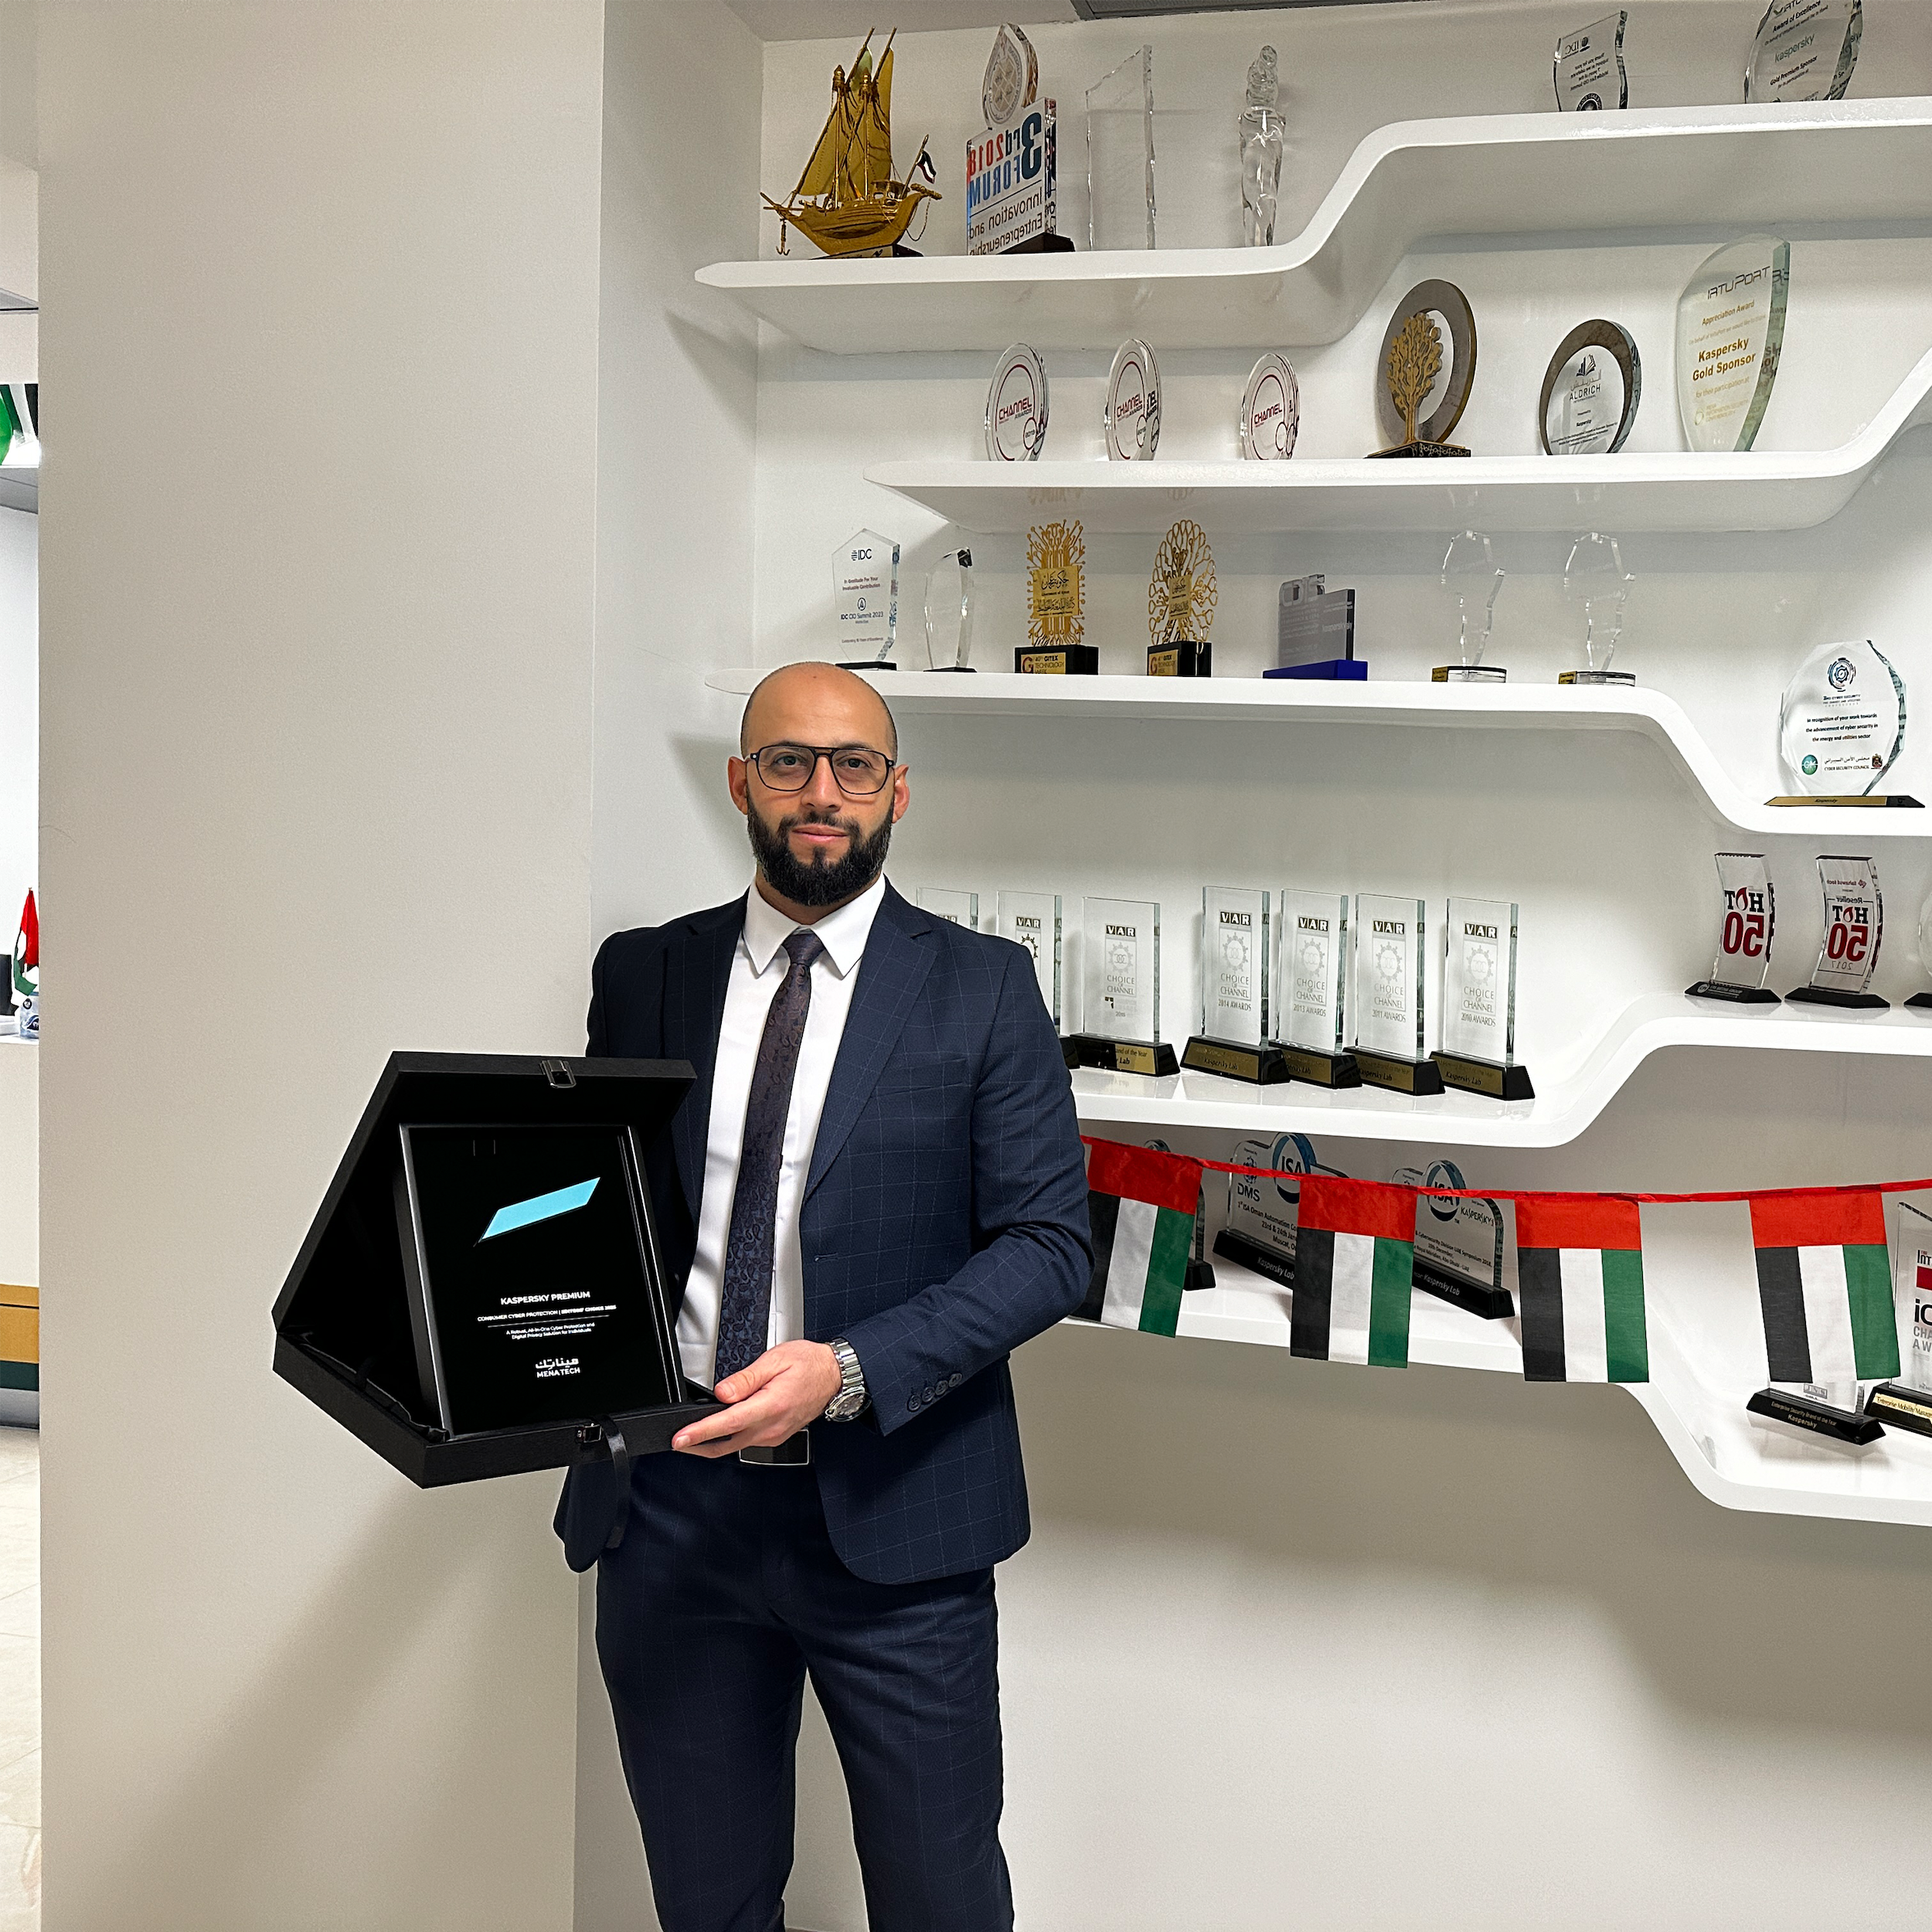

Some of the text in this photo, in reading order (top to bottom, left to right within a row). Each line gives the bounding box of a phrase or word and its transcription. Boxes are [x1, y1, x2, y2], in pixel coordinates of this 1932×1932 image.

[1773, 17, 1789, 32] Award
[1774, 34, 1815, 63] kaspersky
[1702, 308, 1736, 326] Appreciation
[1736, 299, 1755, 313] Award
[1698, 338, 1749, 362] Kaspersky
[1692, 353, 1757, 381] Gold Sponsor
[1570, 384, 1600, 400] ALDRICH
[998, 397, 1032, 420] CHANNEL
[1117, 393, 1142, 418] CHANNEL
[1253, 403, 1282, 424] CHANNEL
[858, 549, 872, 560] IDC
[1016, 917, 1041, 928] VAR
[1220, 912, 1251, 926] VAR
[1298, 917, 1328, 931] VAR
[1106, 925, 1136, 937] VAR
[1373, 920, 1405, 934] VAR
[1464, 923, 1498, 939] VAR
[1107, 975, 1135, 985] CHOICE
[1220, 973, 1250, 985] CHOICE
[1297, 978, 1325, 991] CHOICE
[1107, 985, 1134, 995] CHANNEL
[1220, 986, 1249, 998] CHANNEL
[1374, 983, 1404, 996] CHOICE
[1464, 986, 1495, 1000] CHOICE
[1296, 991, 1325, 1004] CHANNEL
[1374, 996, 1403, 1009] CHANNEL
[1218, 998, 1251, 1012] 2014 AWARDS
[1293, 1004, 1327, 1017] 2013 AWARDS
[1463, 1000, 1494, 1013] CHANNEL
[1383, 1010, 1406, 1022] AWARDS
[1472, 1015, 1496, 1027] AWARDS
[1203, 1058, 1239, 1070] Kaspersky Lab
[1301, 1066, 1311, 1074] Lab
[1446, 1071, 1481, 1086] Kaspersky Lab
[1281, 1155, 1302, 1174] ISA
[1237, 1182, 1260, 1202] DMS
[1250, 1207, 1264, 1217] Oman
[1264, 1213, 1291, 1229] Automation
[1460, 1206, 1491, 1224] KASPERSKY
[1261, 1221, 1272, 1231] 23rd
[1277, 1227, 1287, 1237] 24th
[1272, 1235, 1291, 1250] Muscat,
[1418, 1232, 1440, 1245] Cybersecurity
[1440, 1240, 1454, 1250] Division
[1462, 1250, 1481, 1263] Symposium
[1257, 1257, 1295, 1280] Kaspersky Lab
[1423, 1274, 1450, 1292] Kaspersky
[1450, 1286, 1461, 1296] Lab
[500, 1291, 591, 1305] KASPERSKY PREMIUM
[1771, 1401, 1791, 1412] Enterprise
[1790, 1407, 1805, 1417] Security
[1805, 1412, 1817, 1420] Brand
[1876, 1396, 1915, 1413] Enterprise Mobility
[1787, 1413, 1818, 1429] Kaspersky
